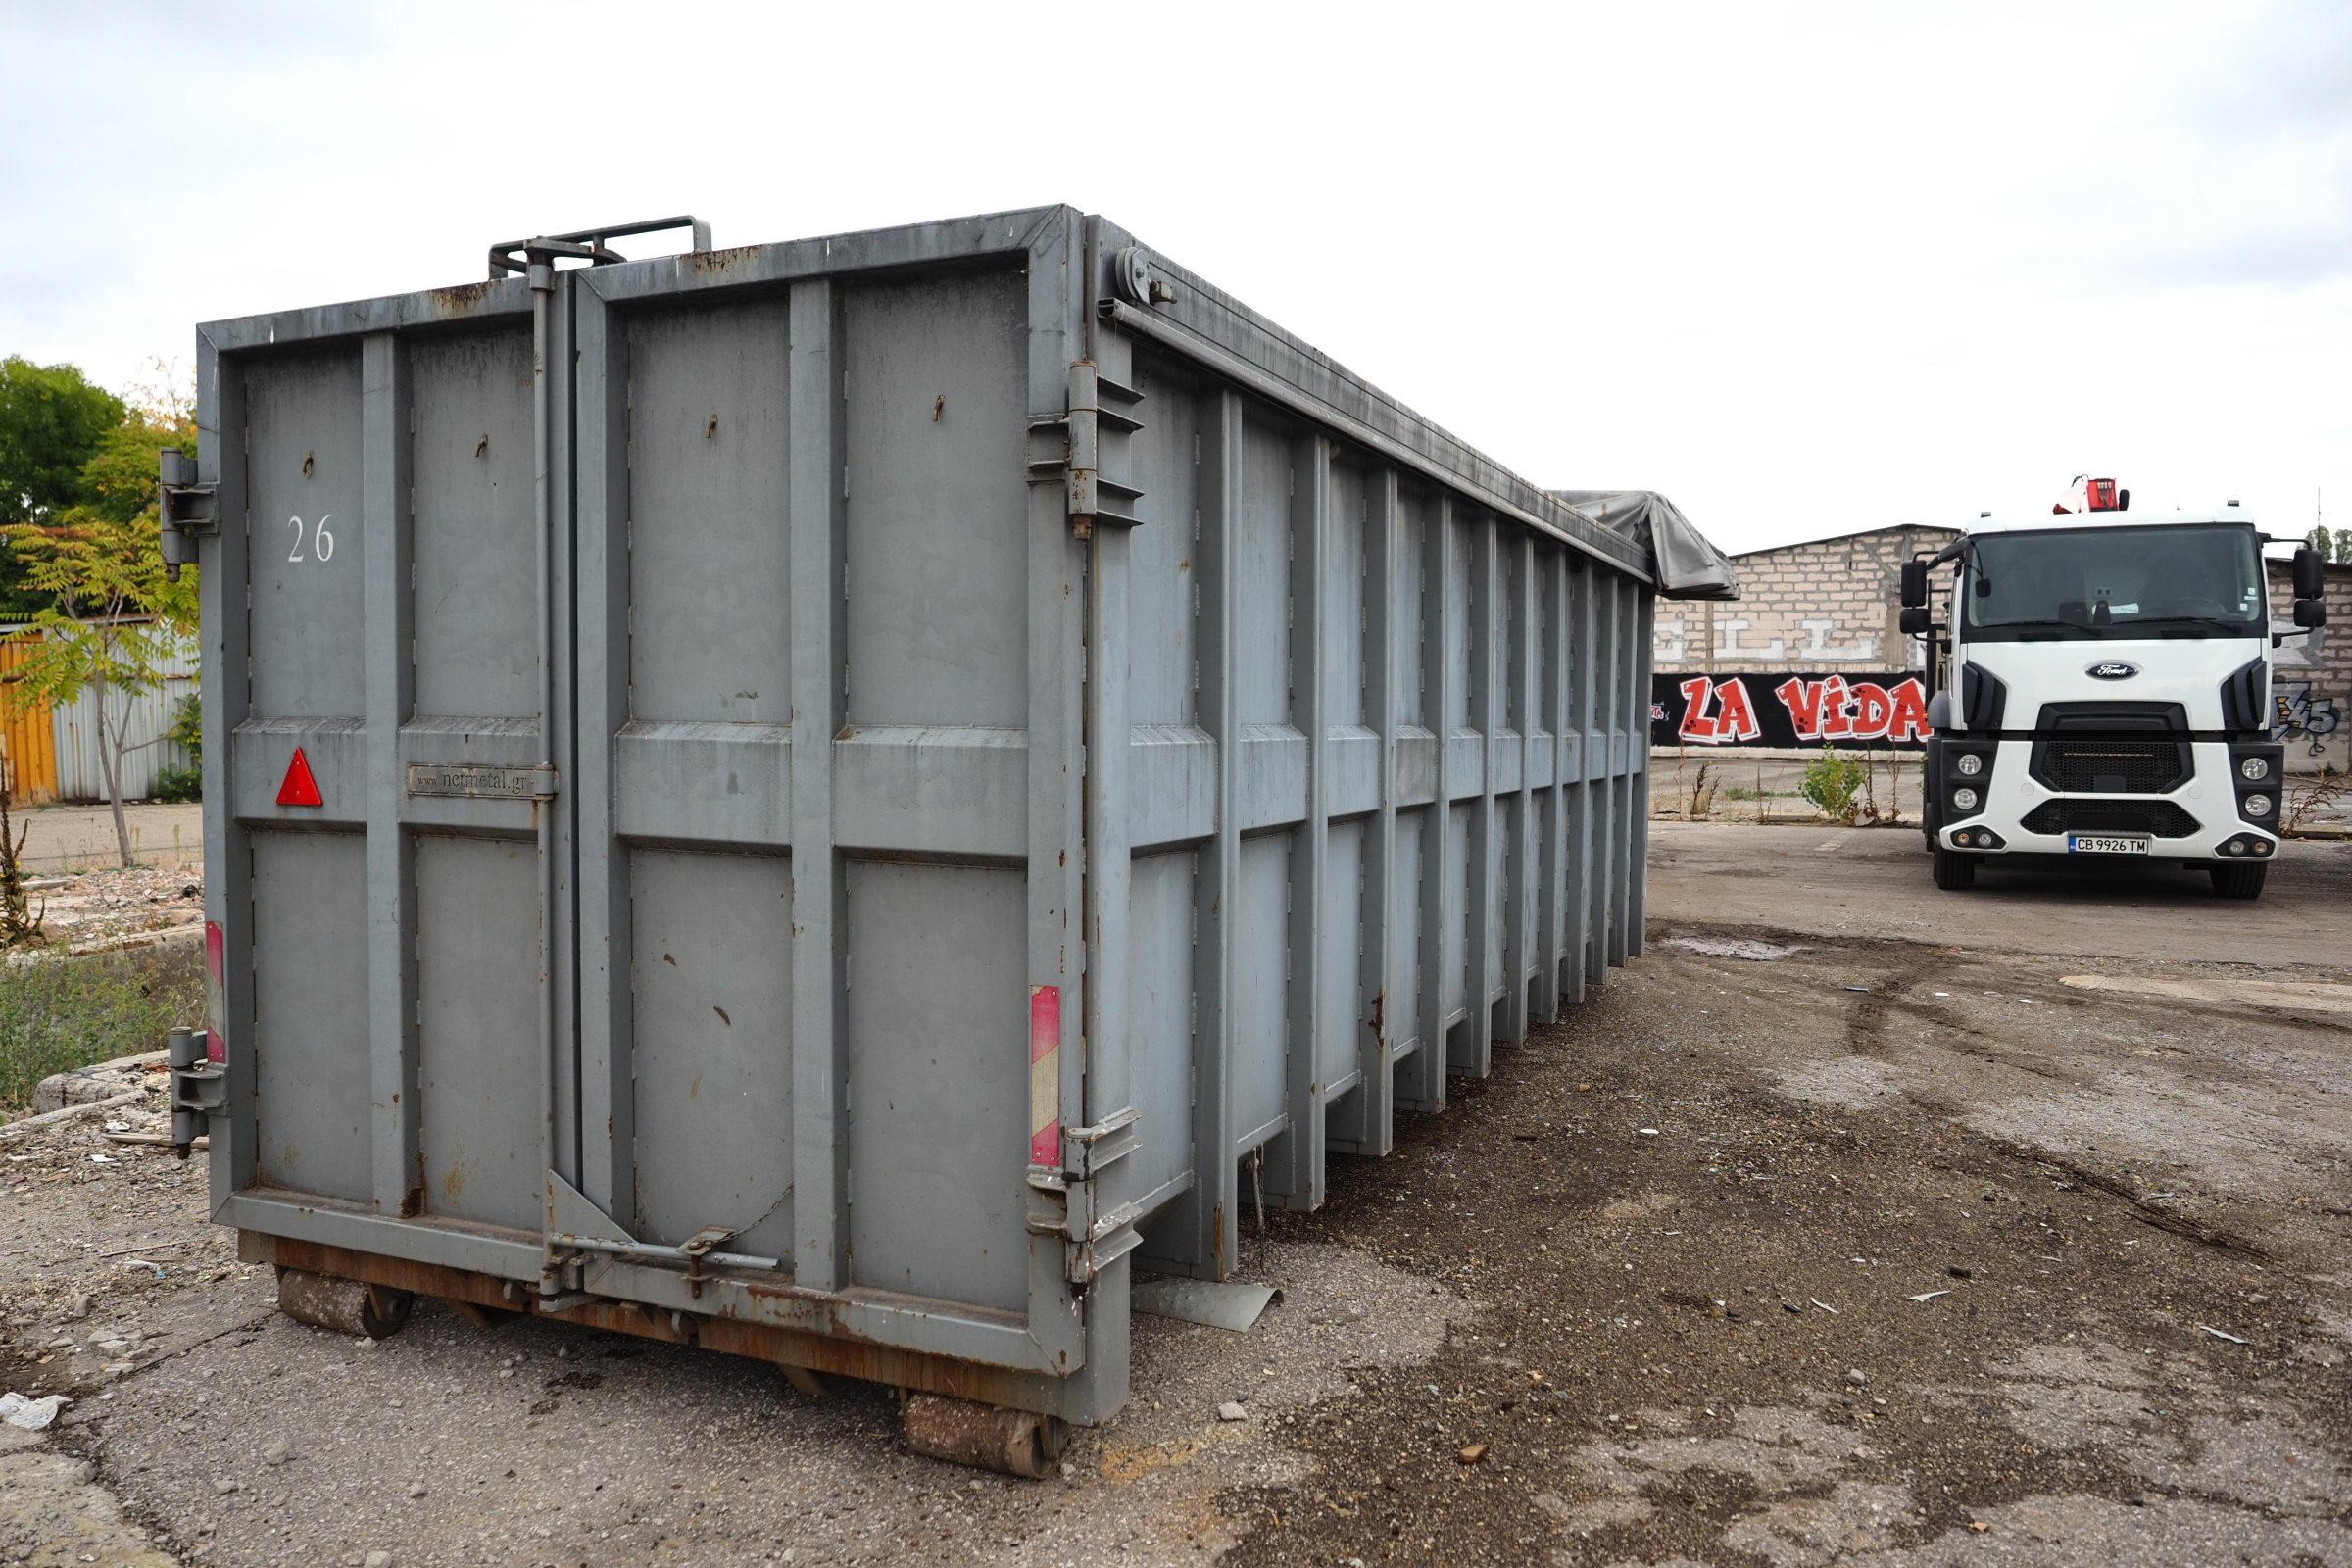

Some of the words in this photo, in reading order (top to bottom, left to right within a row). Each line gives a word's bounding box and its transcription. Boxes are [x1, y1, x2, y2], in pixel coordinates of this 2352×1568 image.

[288, 514, 333, 562] 26
[2097, 664, 2128, 676] Ford
[1679, 675, 1762, 745] LA
[442, 771, 528, 794] netmetal.gr
[2077, 838, 2094, 851] CB
[2096, 839, 2127, 852] 9926
[2129, 840, 2145, 852] TM
